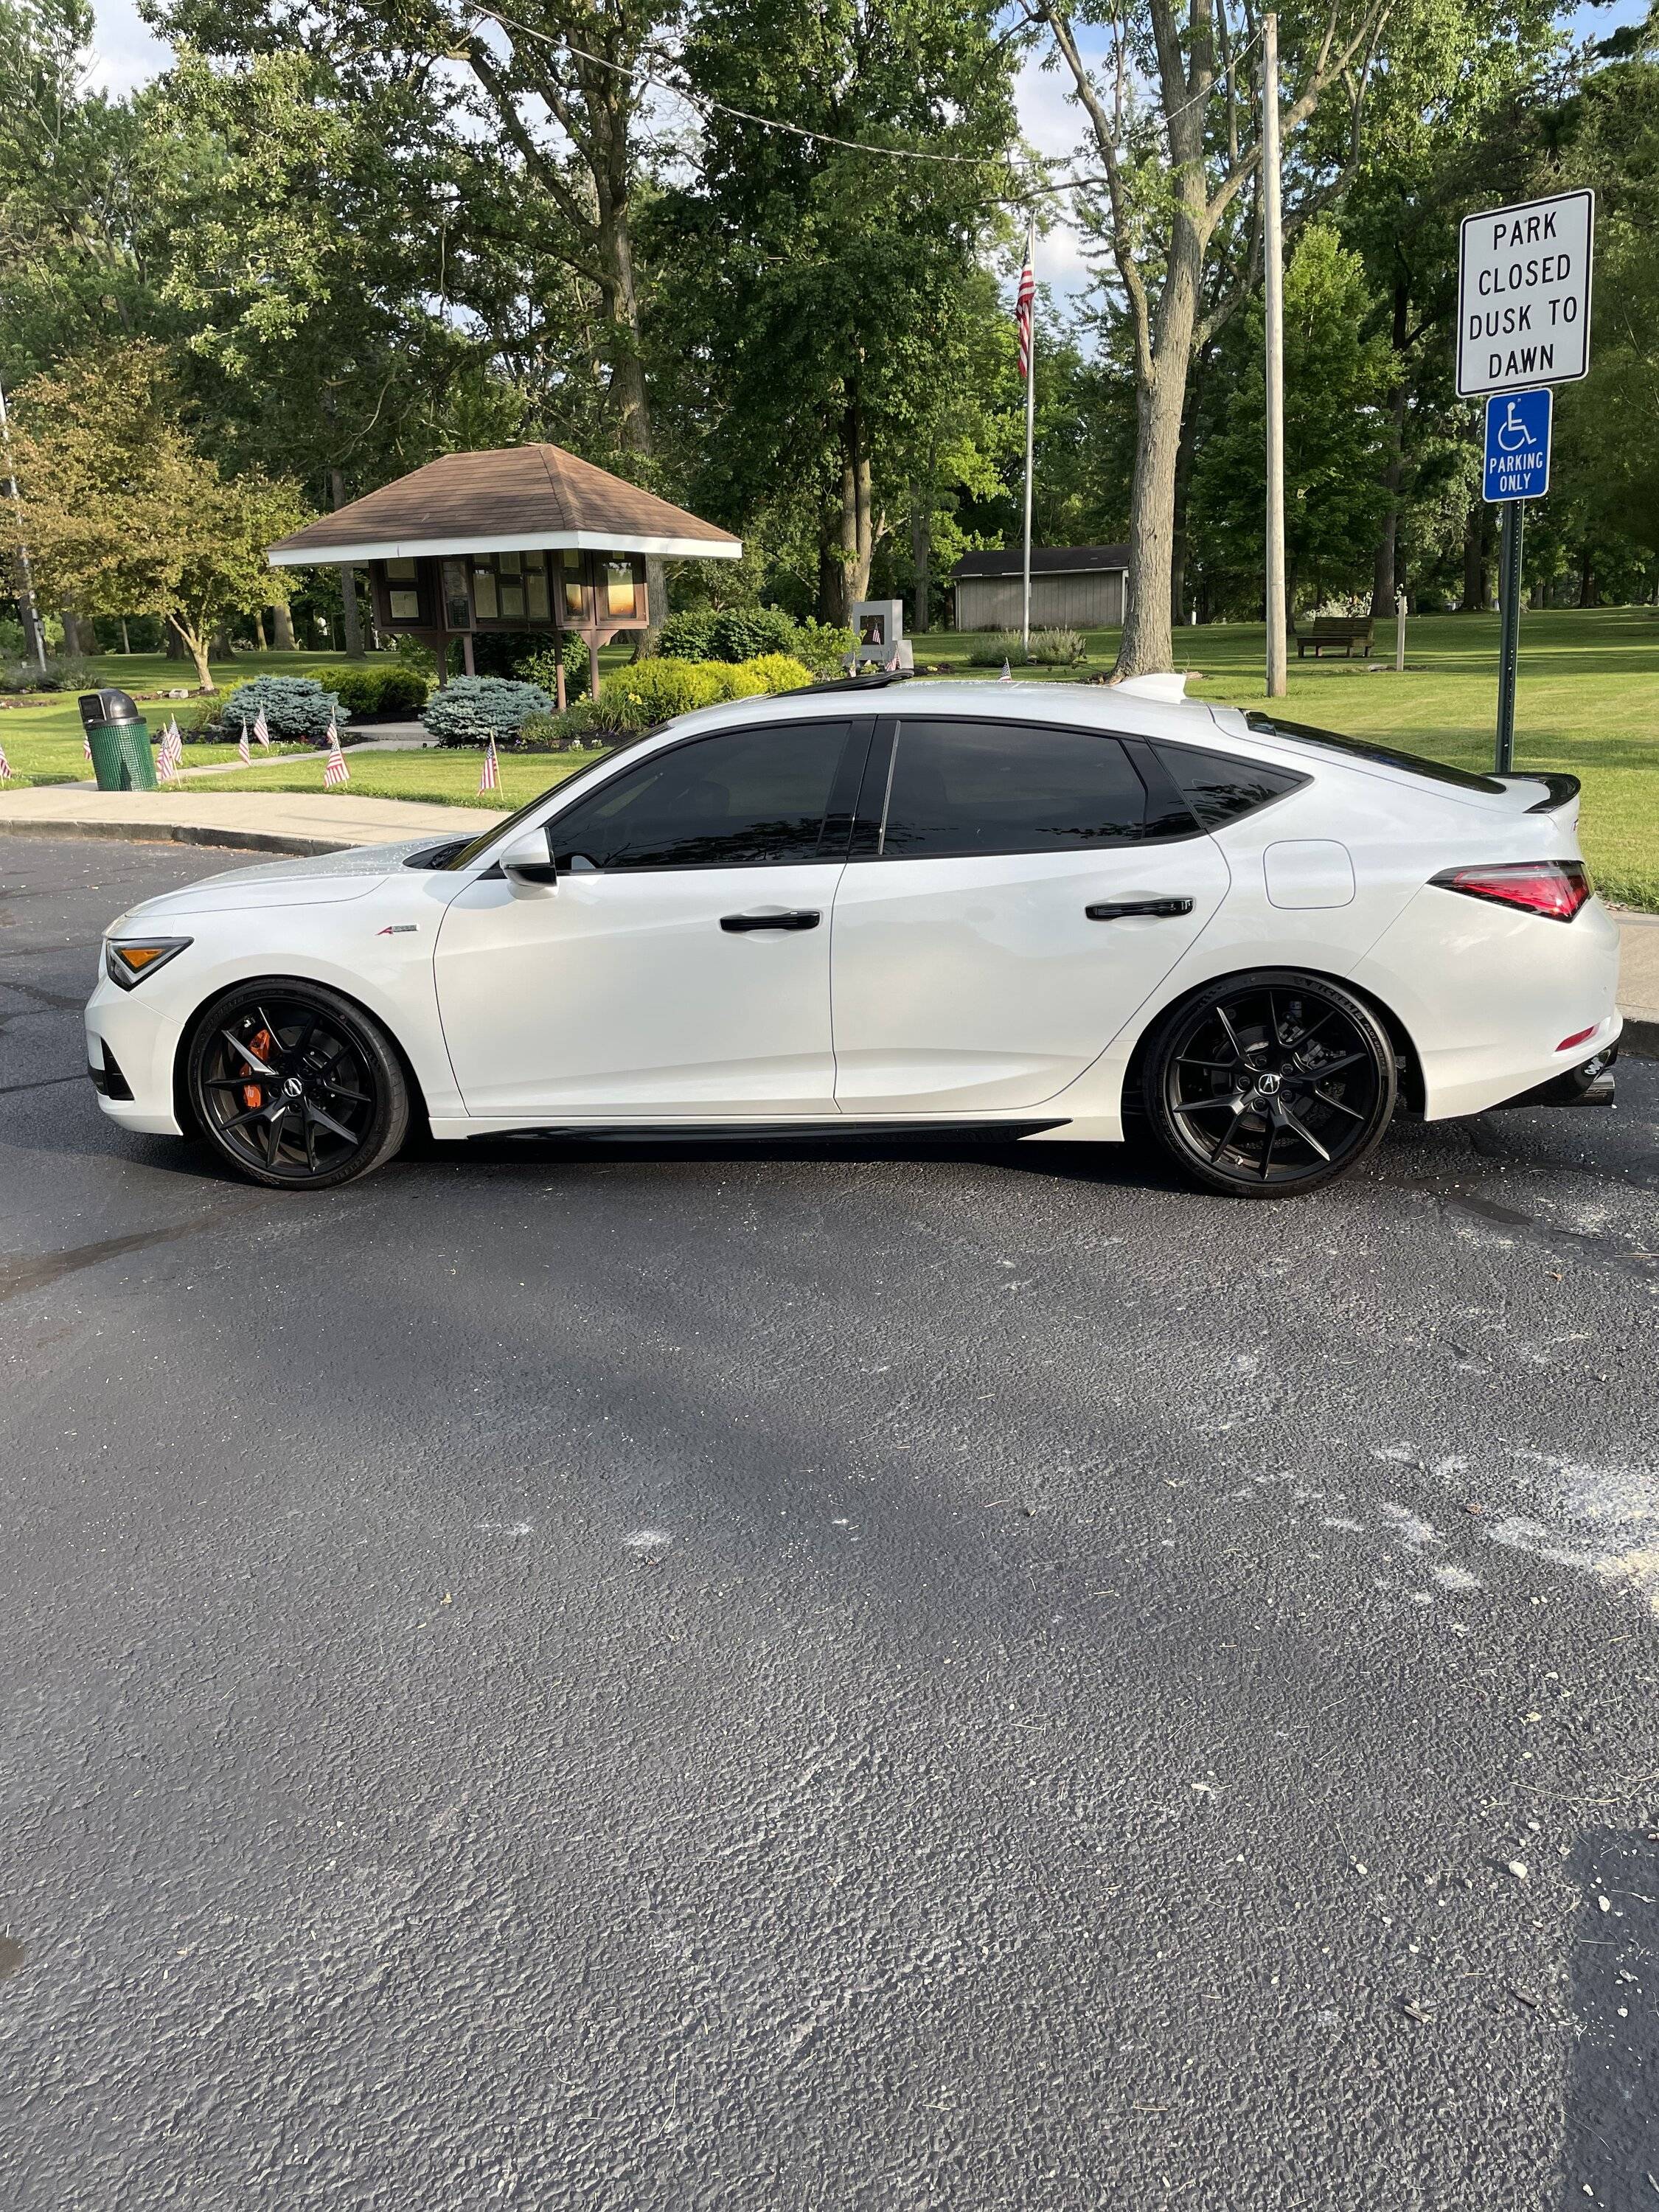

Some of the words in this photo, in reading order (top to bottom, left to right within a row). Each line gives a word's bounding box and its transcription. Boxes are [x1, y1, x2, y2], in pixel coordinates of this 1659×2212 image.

[1494, 212, 1557, 251] PARK
[1479, 254, 1571, 296] CLOSED
[1470, 305, 1531, 340] DUSK
[1548, 296, 1577, 325] TO
[1489, 344, 1554, 378] DAWN
[1489, 451, 1543, 474] PARKING
[1500, 473, 1531, 492] ONLY
[1363, 1023, 1377, 1040] PILOT
